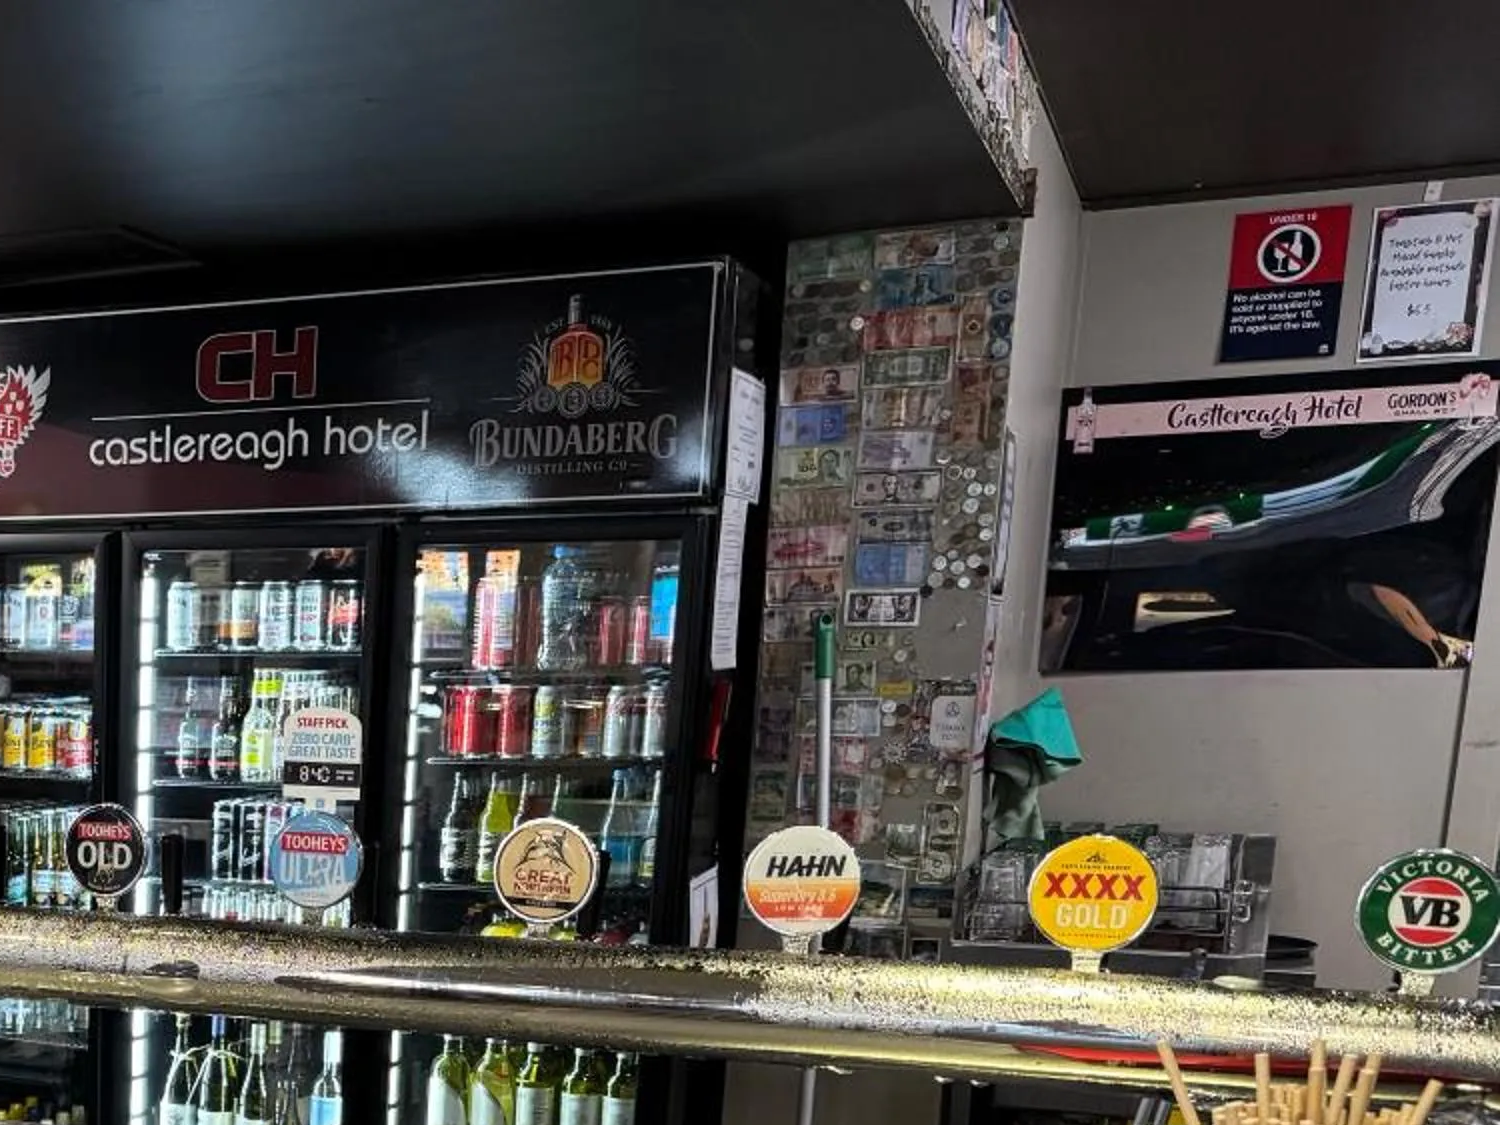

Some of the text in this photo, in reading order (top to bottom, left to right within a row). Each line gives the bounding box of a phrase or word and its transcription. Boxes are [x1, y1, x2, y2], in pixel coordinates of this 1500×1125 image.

[1233, 294, 1247, 303] No
[1287, 291, 1306, 300] can
[1283, 321, 1300, 330] the
[195, 325, 319, 403] CH
[1300, 394, 1364, 423] Hotel
[1387, 390, 1457, 410] GORDON'S
[89, 409, 430, 471] castlereagh hotel
[469, 413, 678, 468] BUNDABERG
[515, 460, 604, 476] DISTILLING
[297, 717, 348, 729] STAFF PICK
[288, 745, 357, 759] GREAT TASTE
[79, 821, 132, 840] TOOHEYS
[285, 834, 346, 852] TOOHEYS
[77, 841, 133, 870] OLD
[280, 851, 346, 885] ULTRA
[765, 855, 847, 878] HAHN
[515, 869, 573, 885] GREAT
[1044, 871, 1146, 901] XXXX
[1377, 860, 1489, 902] VICTORIA
[1056, 903, 1128, 929] GOLD
[1400, 895, 1461, 928] VB
[1376, 931, 1474, 964] BITTER
